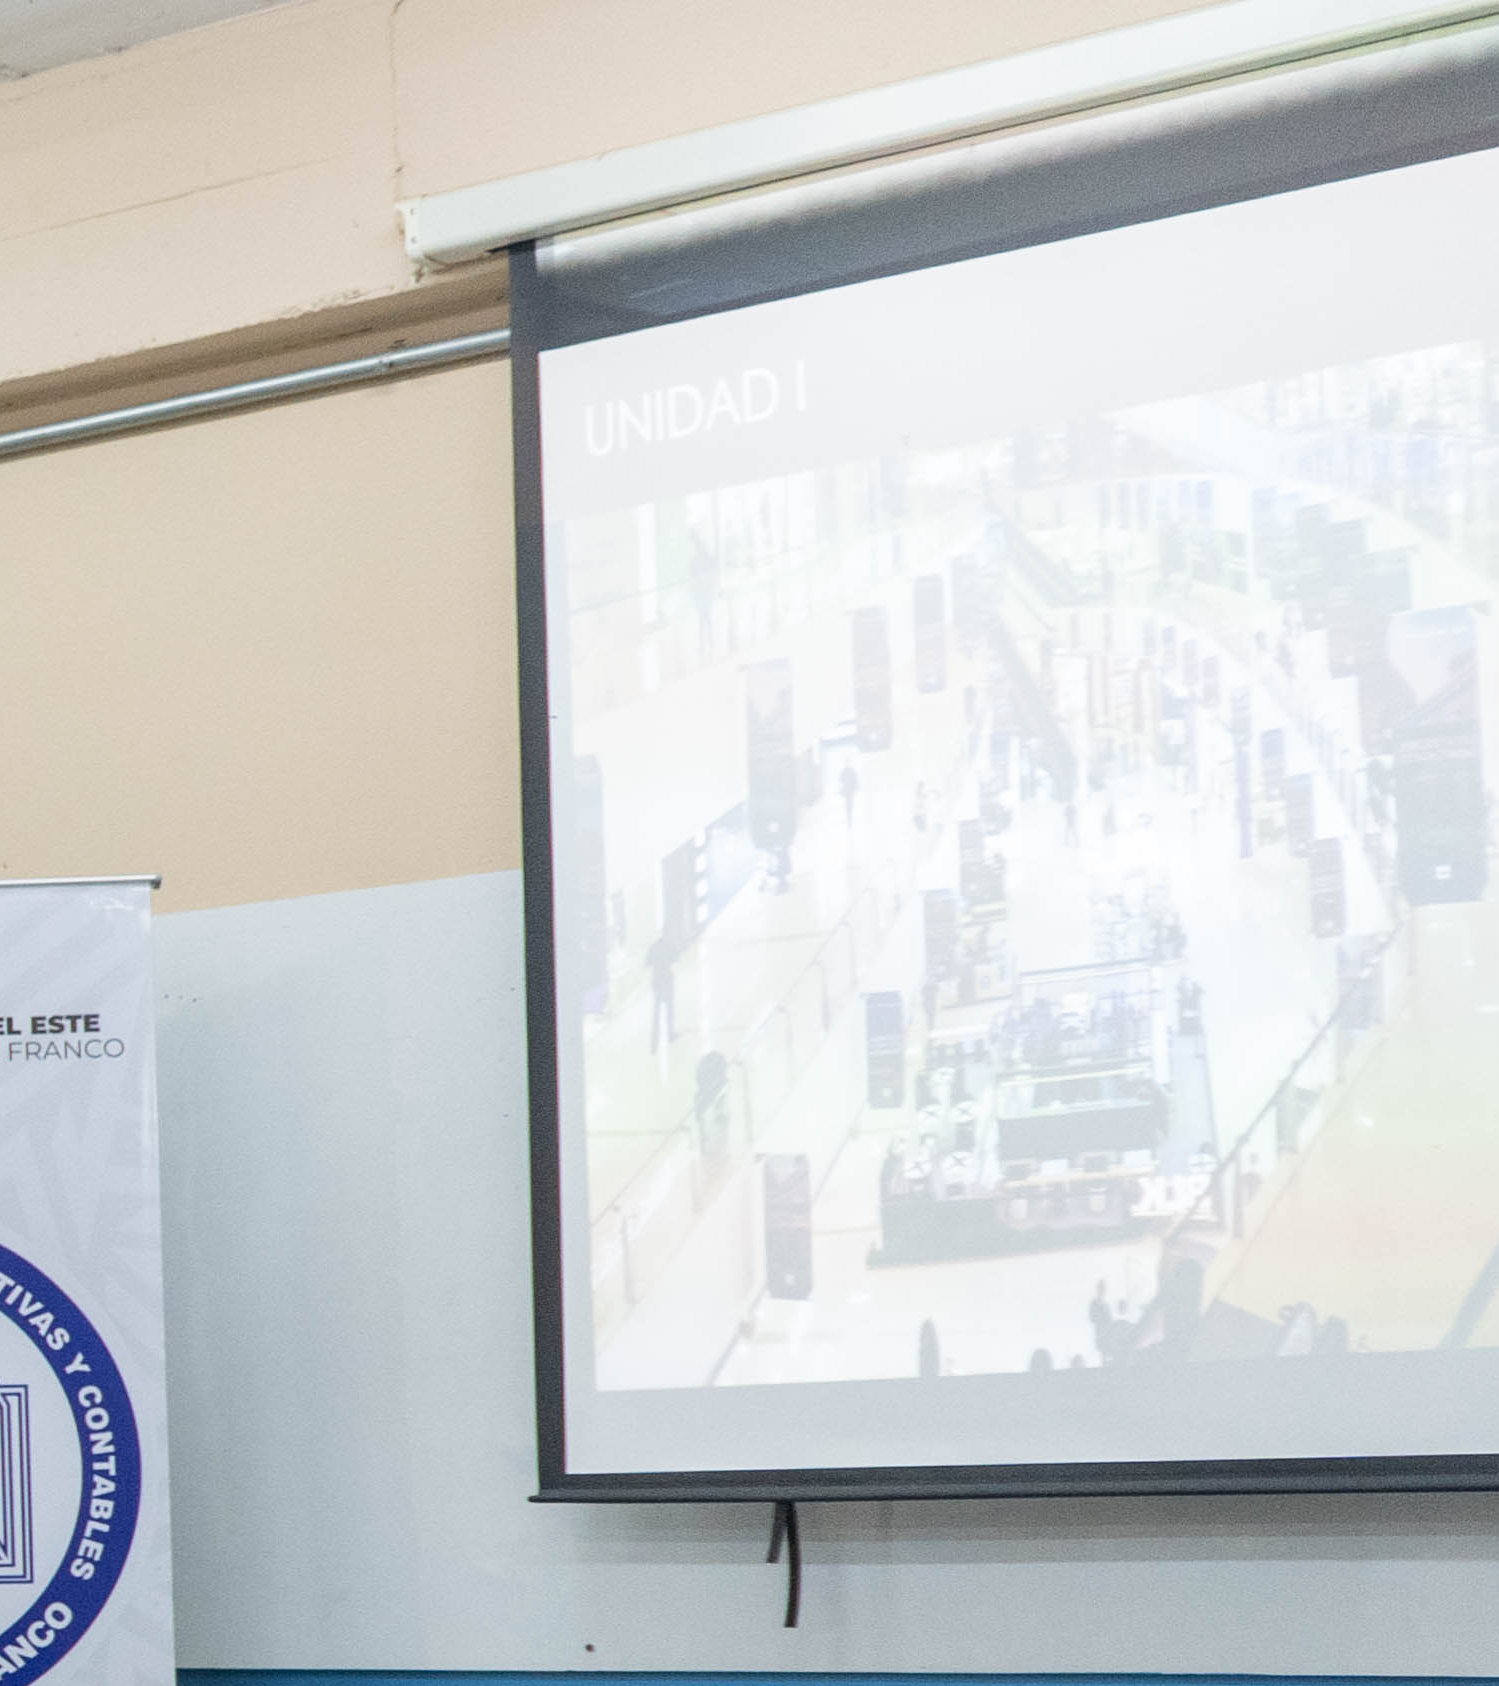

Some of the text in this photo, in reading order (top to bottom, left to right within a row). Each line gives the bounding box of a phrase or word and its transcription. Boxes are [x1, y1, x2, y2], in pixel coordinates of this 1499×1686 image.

[584, 367, 781, 457] UNIDAD
[31, 1013, 102, 1035] ESTE
[7, 1037, 126, 1062] FRANCO
[63, 1351, 92, 1376] Y
[69, 1384, 118, 1581] CONTABLES
